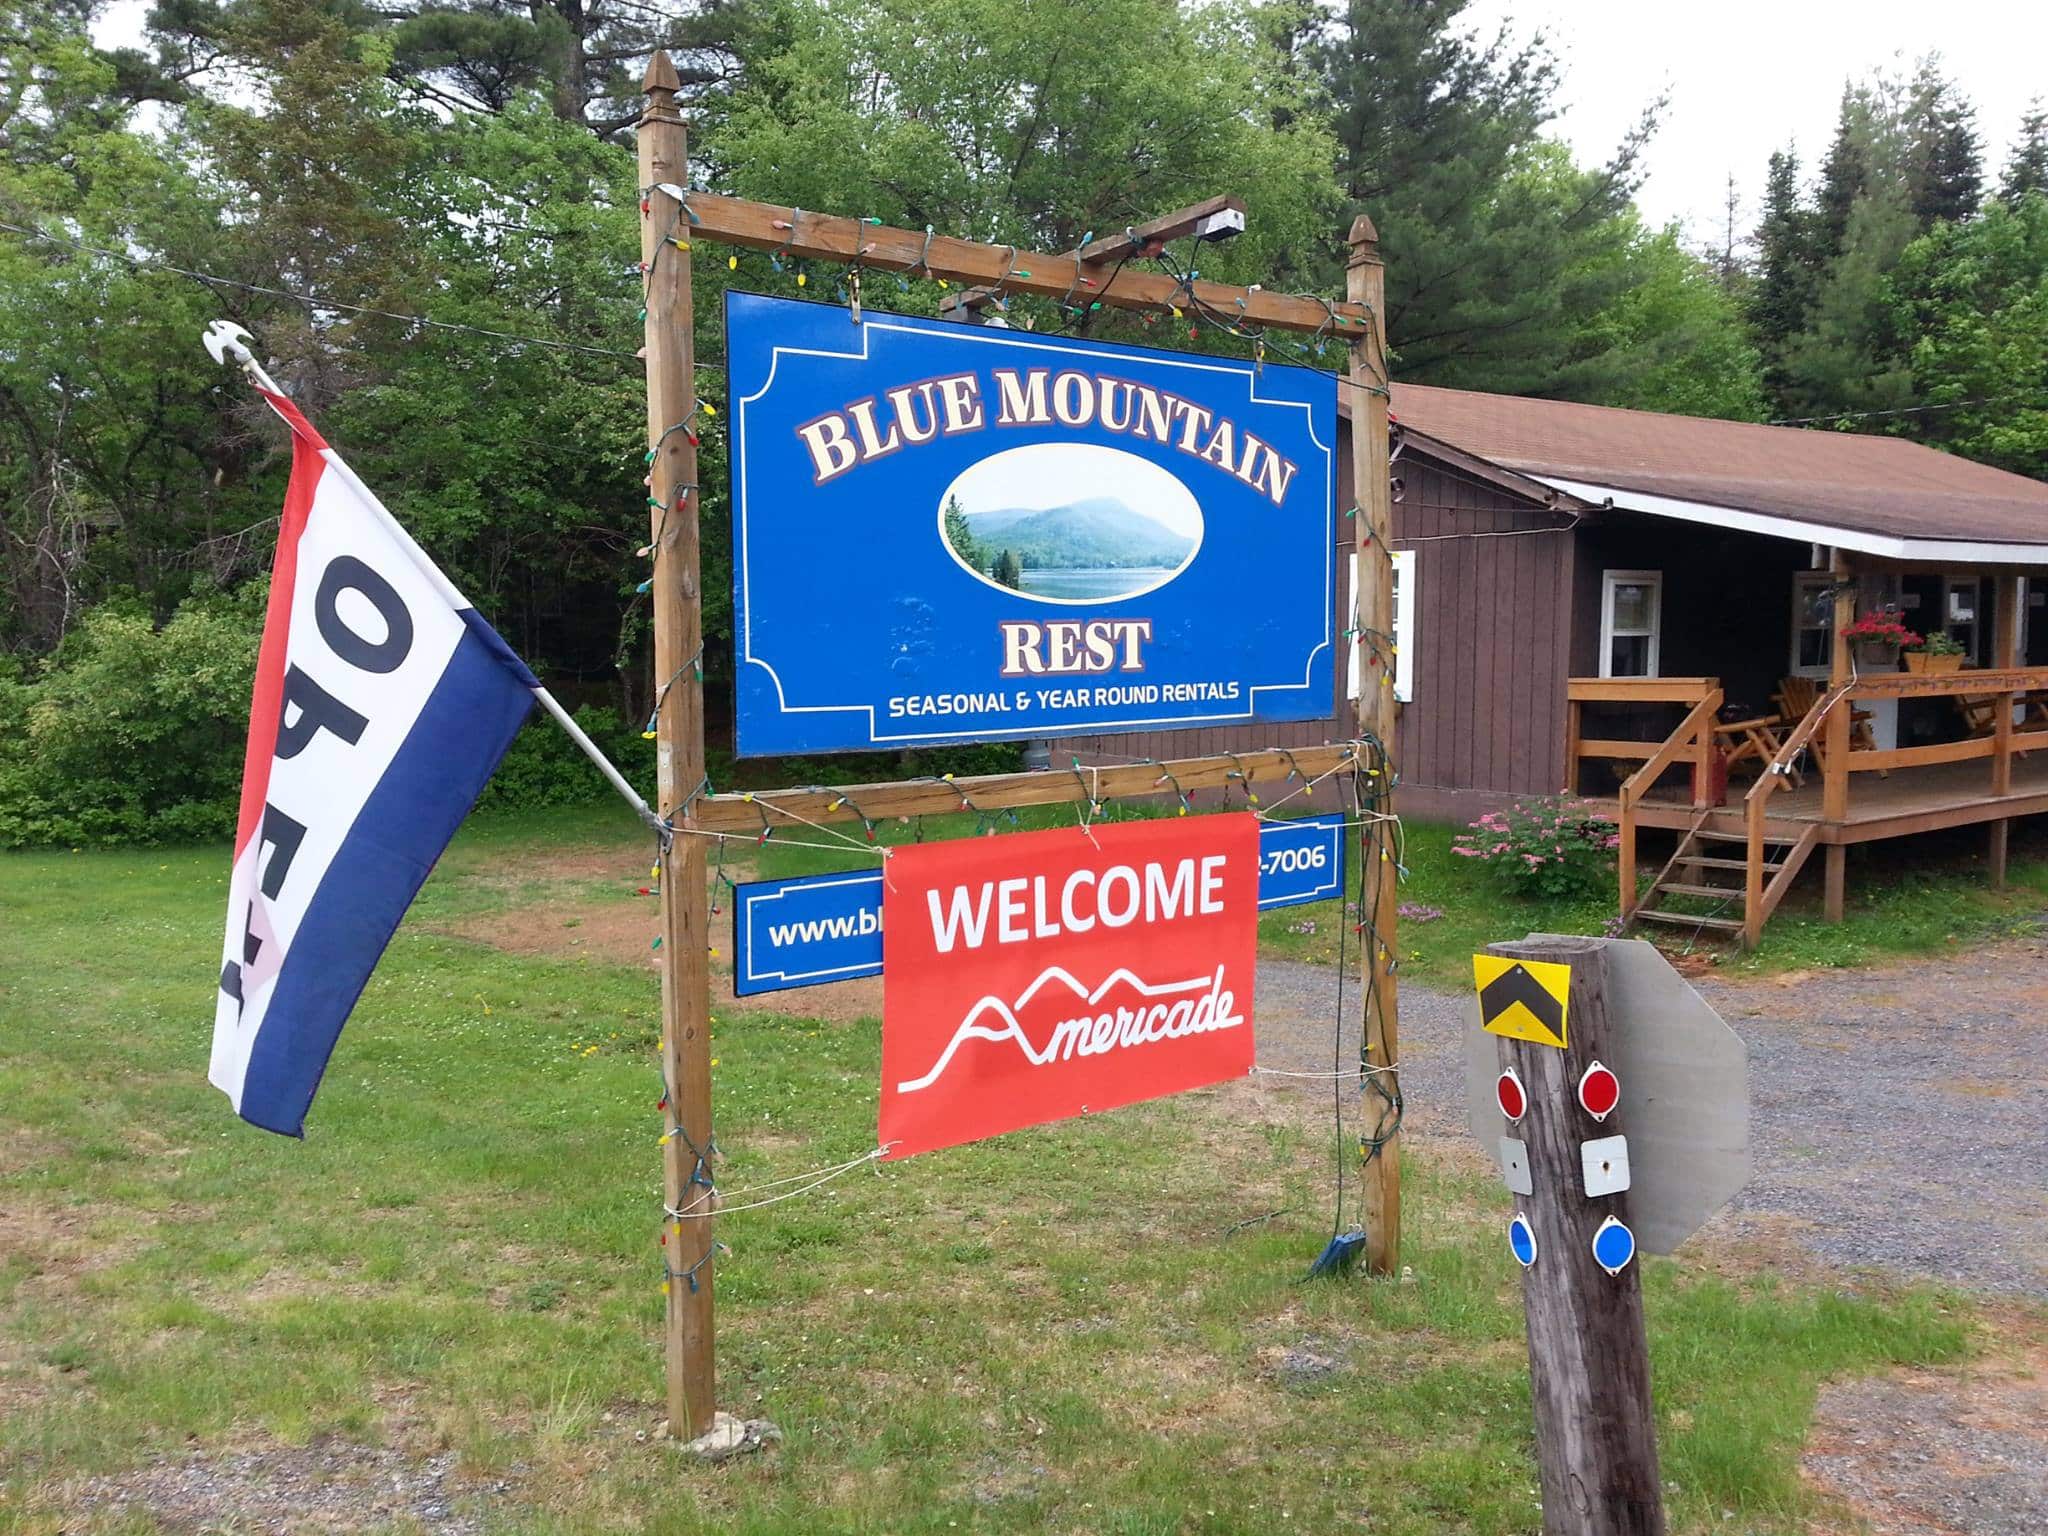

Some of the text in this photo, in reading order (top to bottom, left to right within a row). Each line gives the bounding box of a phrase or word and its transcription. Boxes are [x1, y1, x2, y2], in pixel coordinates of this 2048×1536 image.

[799, 366, 1297, 505] BLUE MOUNTAIN
[1000, 617, 1152, 677] REST
[888, 681, 1241, 718] SEASONAL & YEAR ROUND RENTALS
[1258, 844, 1327, 877] -7006
[926, 854, 1228, 953] WELCOME
[898, 964, 1244, 1093] Americade
